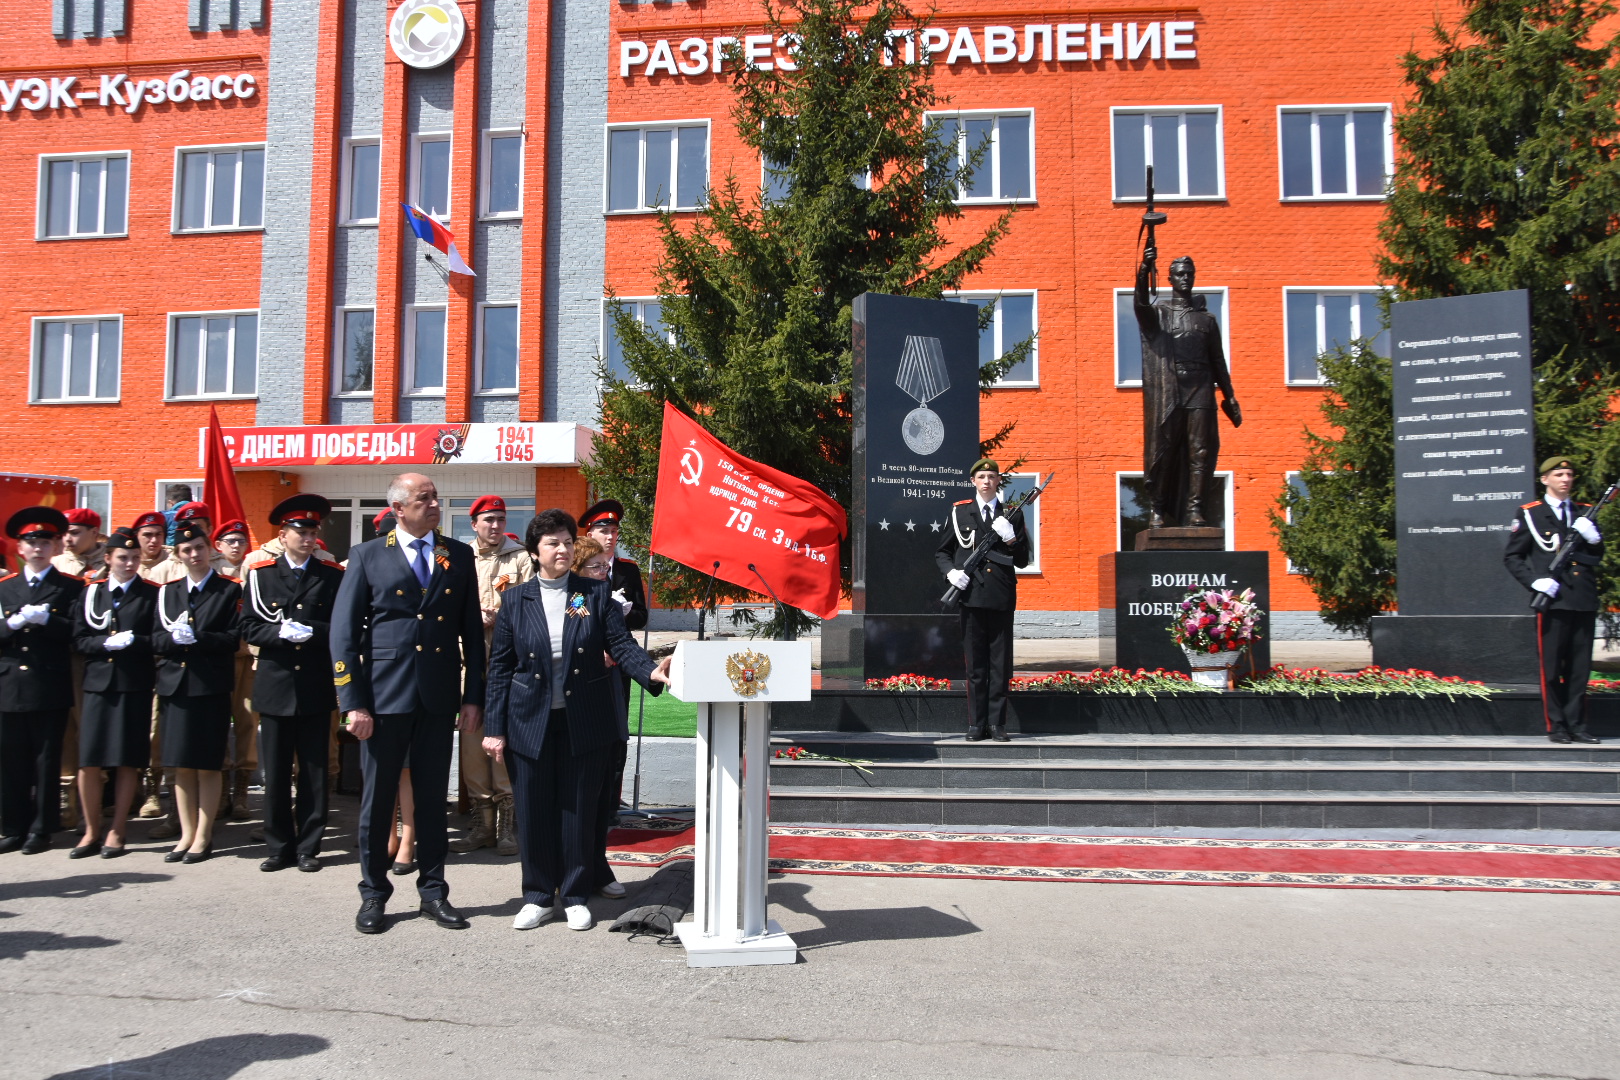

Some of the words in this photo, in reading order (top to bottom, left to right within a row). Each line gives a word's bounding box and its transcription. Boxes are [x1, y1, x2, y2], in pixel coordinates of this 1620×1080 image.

[497, 426, 534, 444] 1941
[240, 434, 305, 463] ДНЕМ
[312, 432, 416, 459] ПОБЕДЫ!
[495, 444, 534, 462] 1945
[717, 458, 734, 472] 150
[882, 463, 888, 471] В
[938, 466, 963, 475] Победы
[877, 475, 905, 484] Великой
[906, 477, 955, 487] Отечественной
[902, 488, 946, 499] 1941-1945
[725, 506, 753, 533] 79
[772, 528, 785, 545] 3
[805, 543, 811, 557] 1
[1151, 573, 1227, 587] ВОИНАМ
